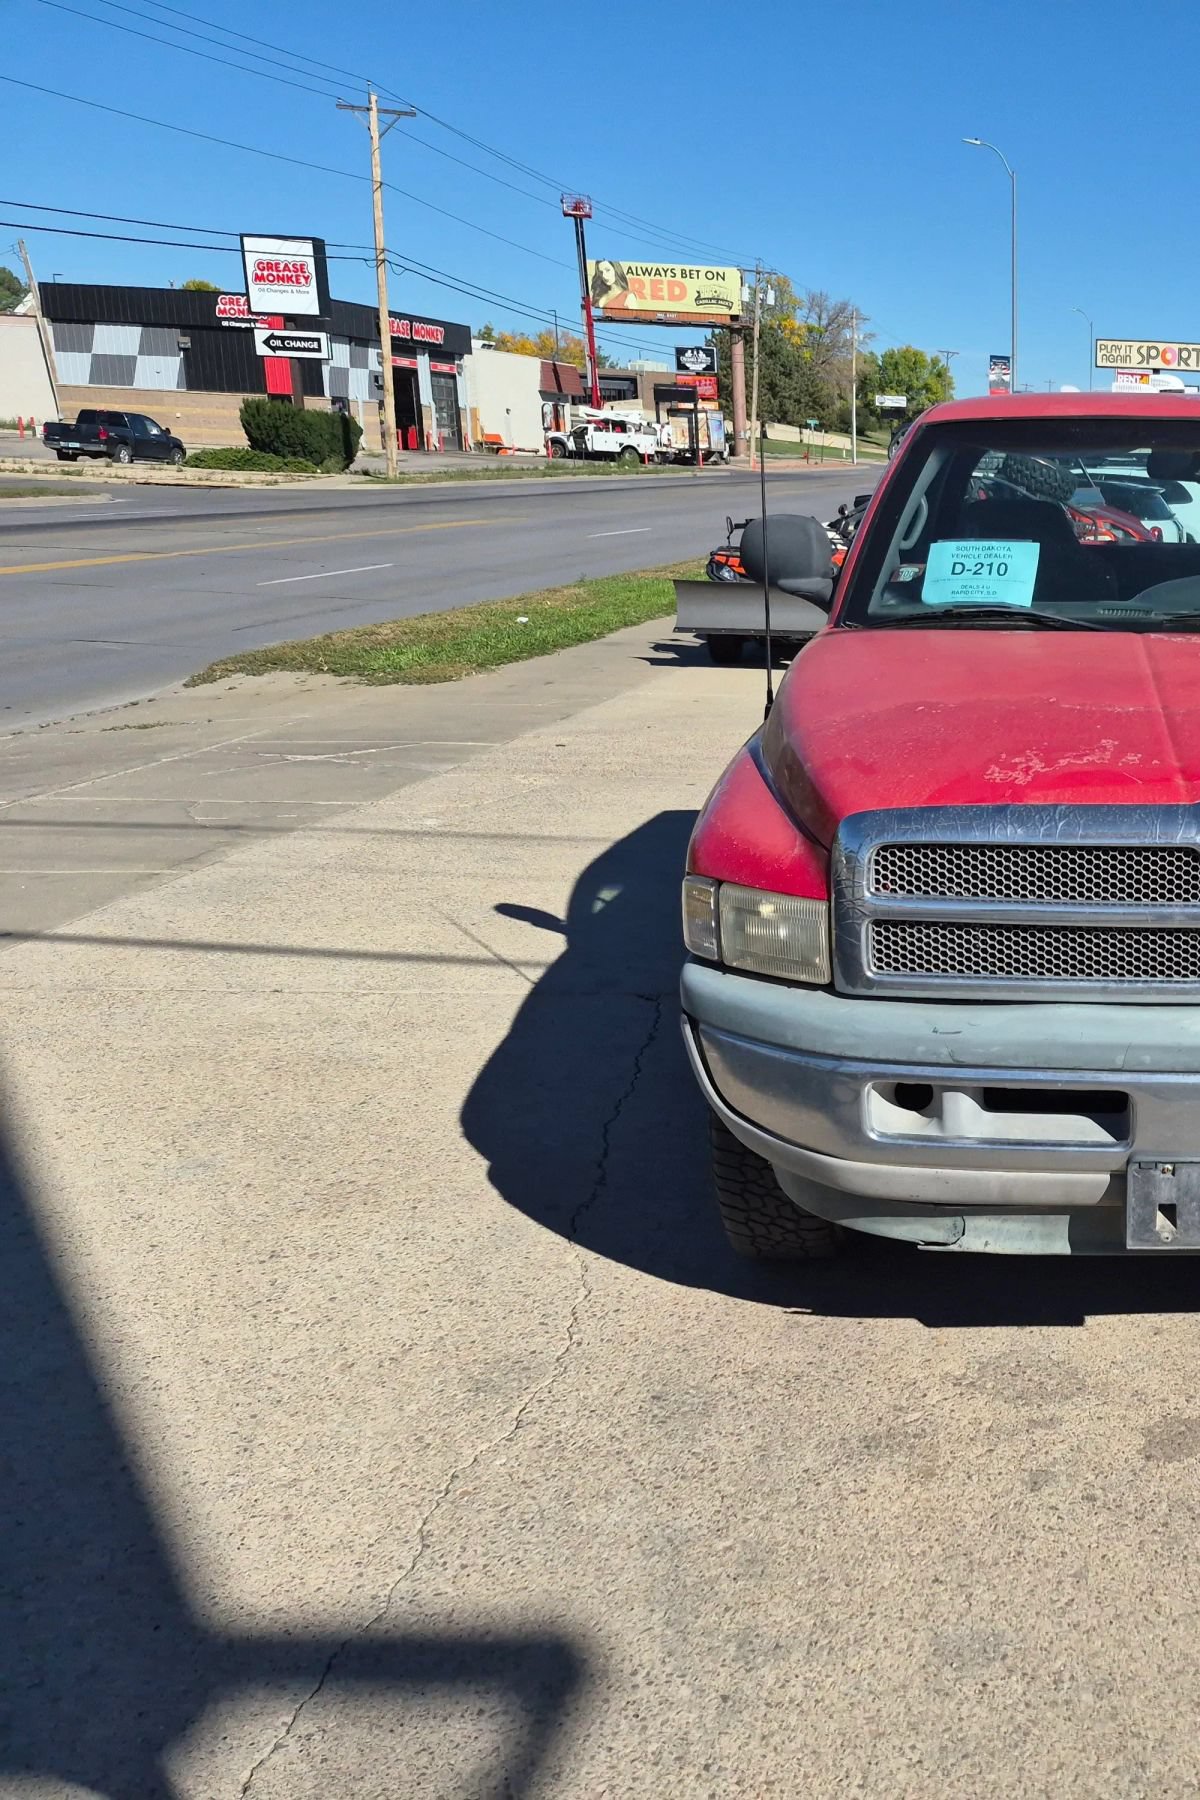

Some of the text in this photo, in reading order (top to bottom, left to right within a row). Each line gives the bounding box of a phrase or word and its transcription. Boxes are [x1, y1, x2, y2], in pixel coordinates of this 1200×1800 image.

[255, 260, 308, 274] GREASE
[626, 265, 726, 281] ALWAYS BET ON
[253, 272, 312, 286] MONKEY
[628, 278, 687, 302] RED
[217, 295, 249, 307] GREA
[389, 318, 445, 344] EASE MONKEY
[270, 339, 318, 348] OIL CHANGE
[1099, 344, 1133, 354] PLAY IT
[1101, 353, 1132, 364] AGAIN
[951, 561, 1009, 577] D-210
